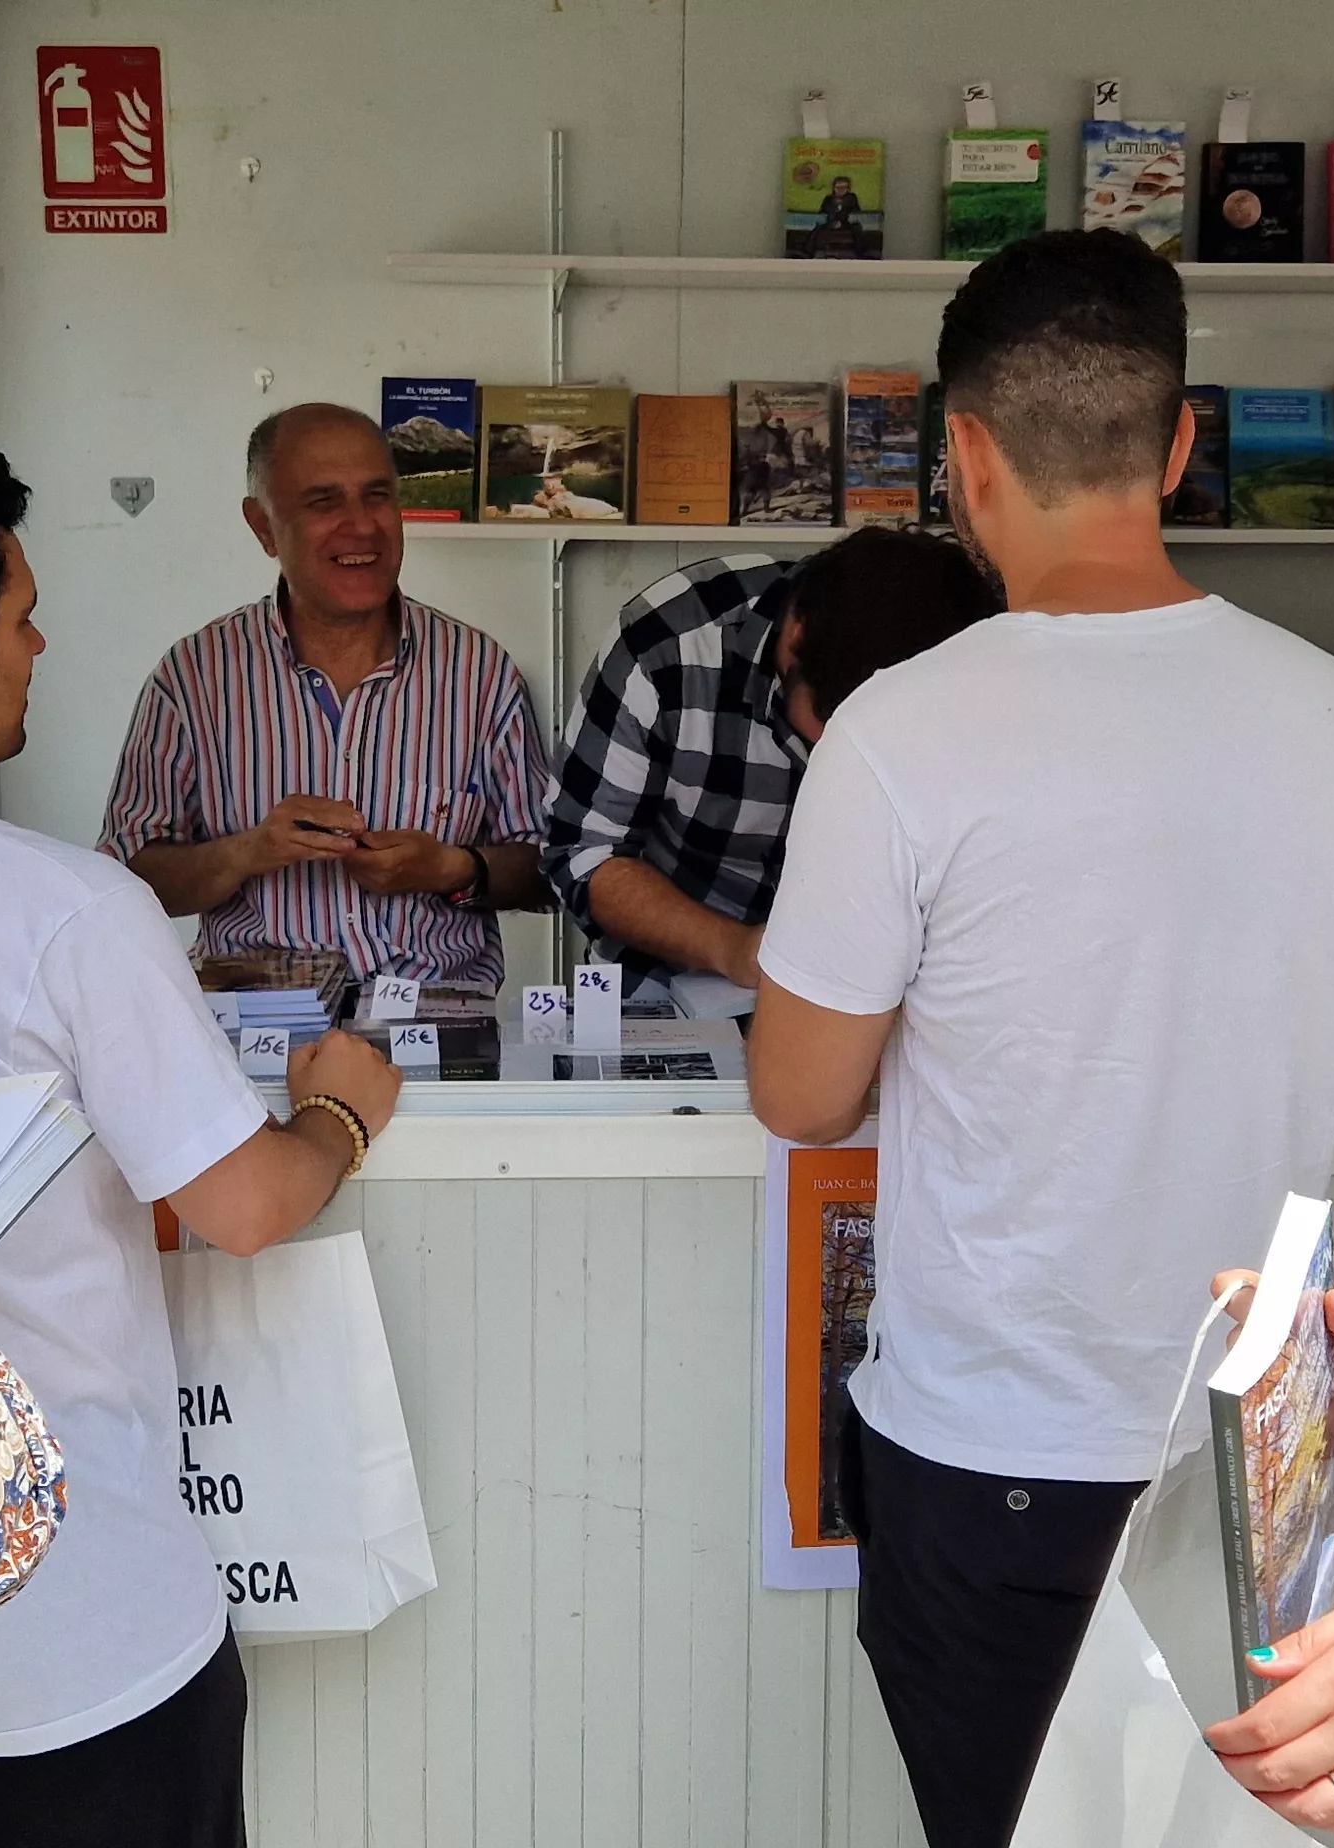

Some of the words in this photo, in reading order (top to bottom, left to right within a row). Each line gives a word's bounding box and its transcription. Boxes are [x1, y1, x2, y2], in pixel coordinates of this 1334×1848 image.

[53, 211, 158, 229] EXTINTOR
[377, 982, 415, 1003] 17€
[578, 971, 612, 993] 28€
[243, 1034, 286, 1055] 15€
[395, 1028, 434, 1046] 15€
[812, 1179, 844, 1191] JUAN
[179, 1431, 202, 1475] L
[215, 1560, 299, 1605] SCA
